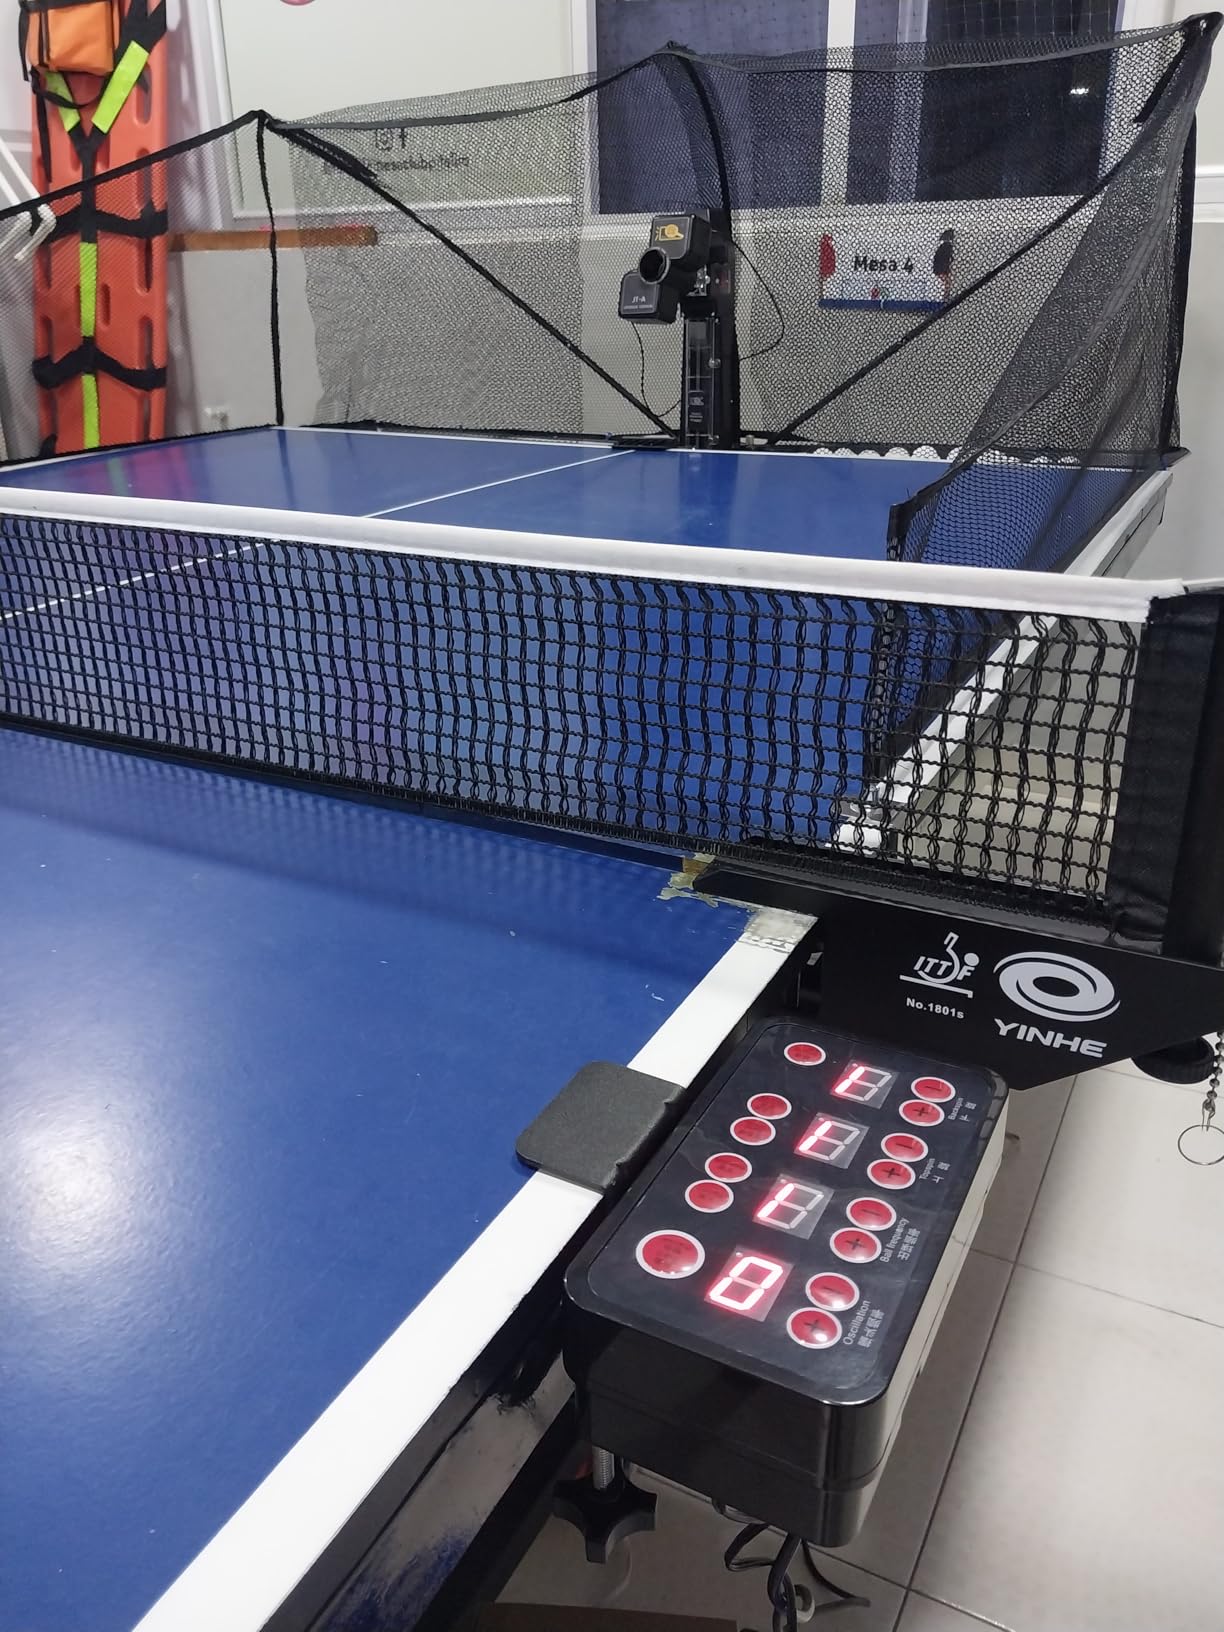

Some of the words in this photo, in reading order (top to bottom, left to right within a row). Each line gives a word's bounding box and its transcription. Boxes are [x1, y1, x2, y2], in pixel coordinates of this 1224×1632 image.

[854, 255, 898, 272] Mesa
[902, 256, 914, 273] 4
[913, 955, 976, 981] ITTF
[906, 997, 965, 1019] No.1801s
[994, 1018, 1108, 1058] YINHE
[879, 1245, 893, 1263] Ball
[889, 1217, 910, 1250] frequency
[843, 1300, 871, 1345] Oscillation
